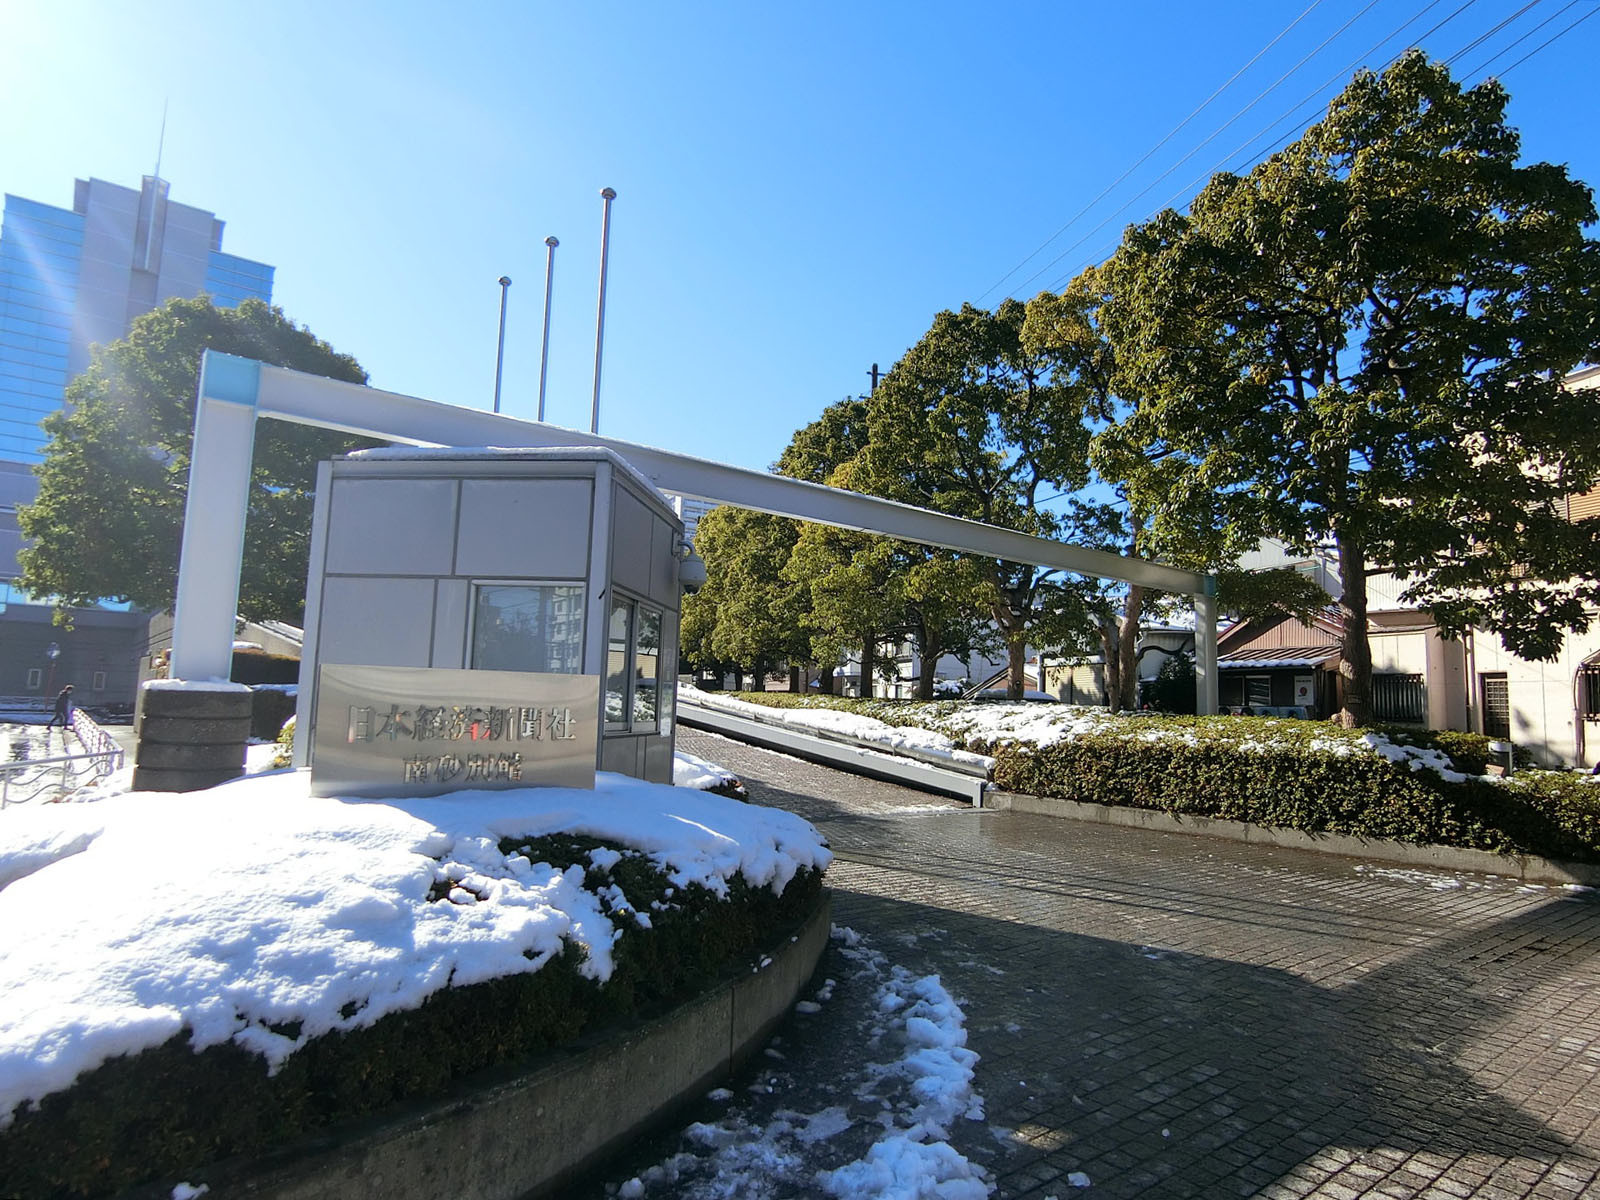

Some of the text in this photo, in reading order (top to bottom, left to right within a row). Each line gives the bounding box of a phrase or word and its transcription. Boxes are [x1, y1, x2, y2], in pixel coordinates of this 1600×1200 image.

[348, 704, 577, 743] 日本経済新聞社
[402, 752, 524, 784] 南砂別館
